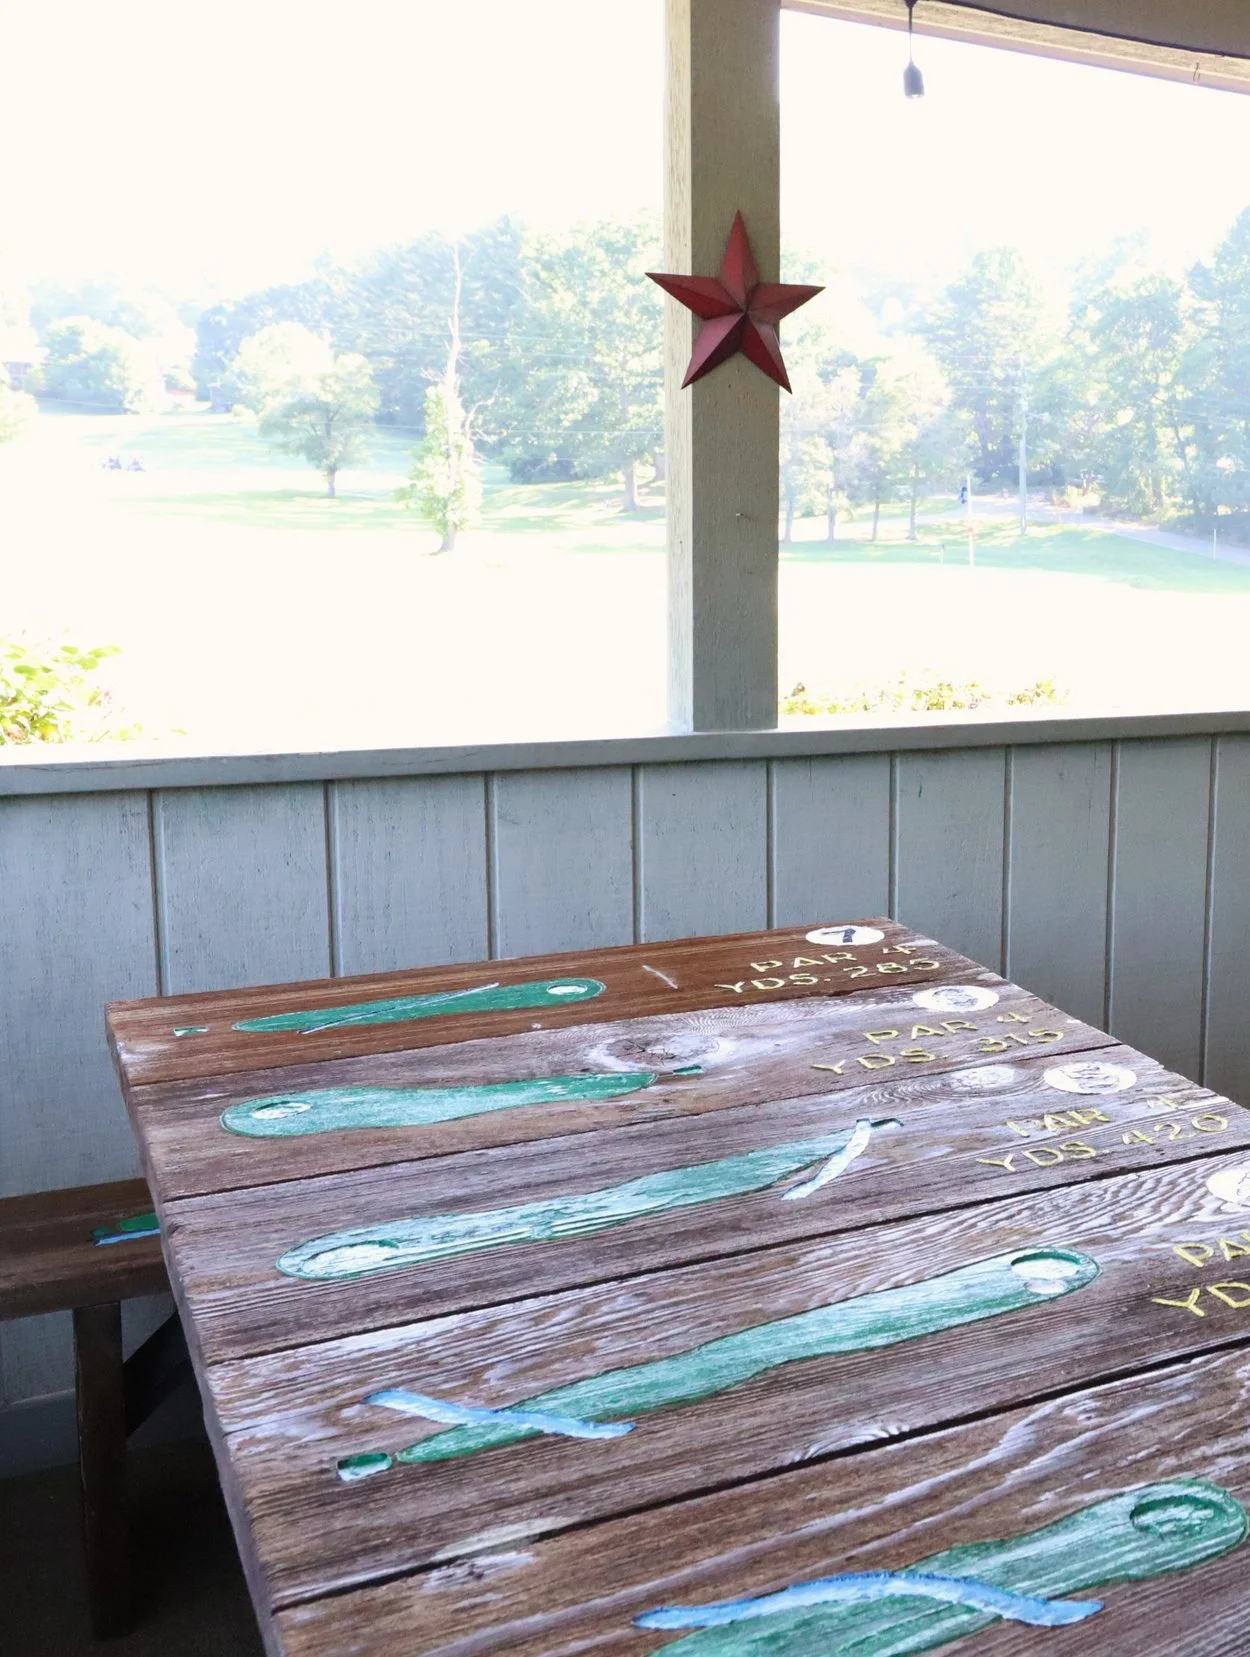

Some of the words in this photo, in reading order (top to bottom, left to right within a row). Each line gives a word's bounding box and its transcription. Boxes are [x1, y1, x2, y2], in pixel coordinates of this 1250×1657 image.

[820, 928, 857, 943] 7
[714, 973, 831, 993] YDS.
[843, 957, 940, 978] 285
[750, 951, 858, 972] PAR
[863, 1019, 979, 1044] PAR
[996, 1012, 1033, 1024] 4
[977, 1028, 1064, 1053] 315
[1006, 1107, 1111, 1138] PAR
[1122, 1113, 1229, 1145] 420
